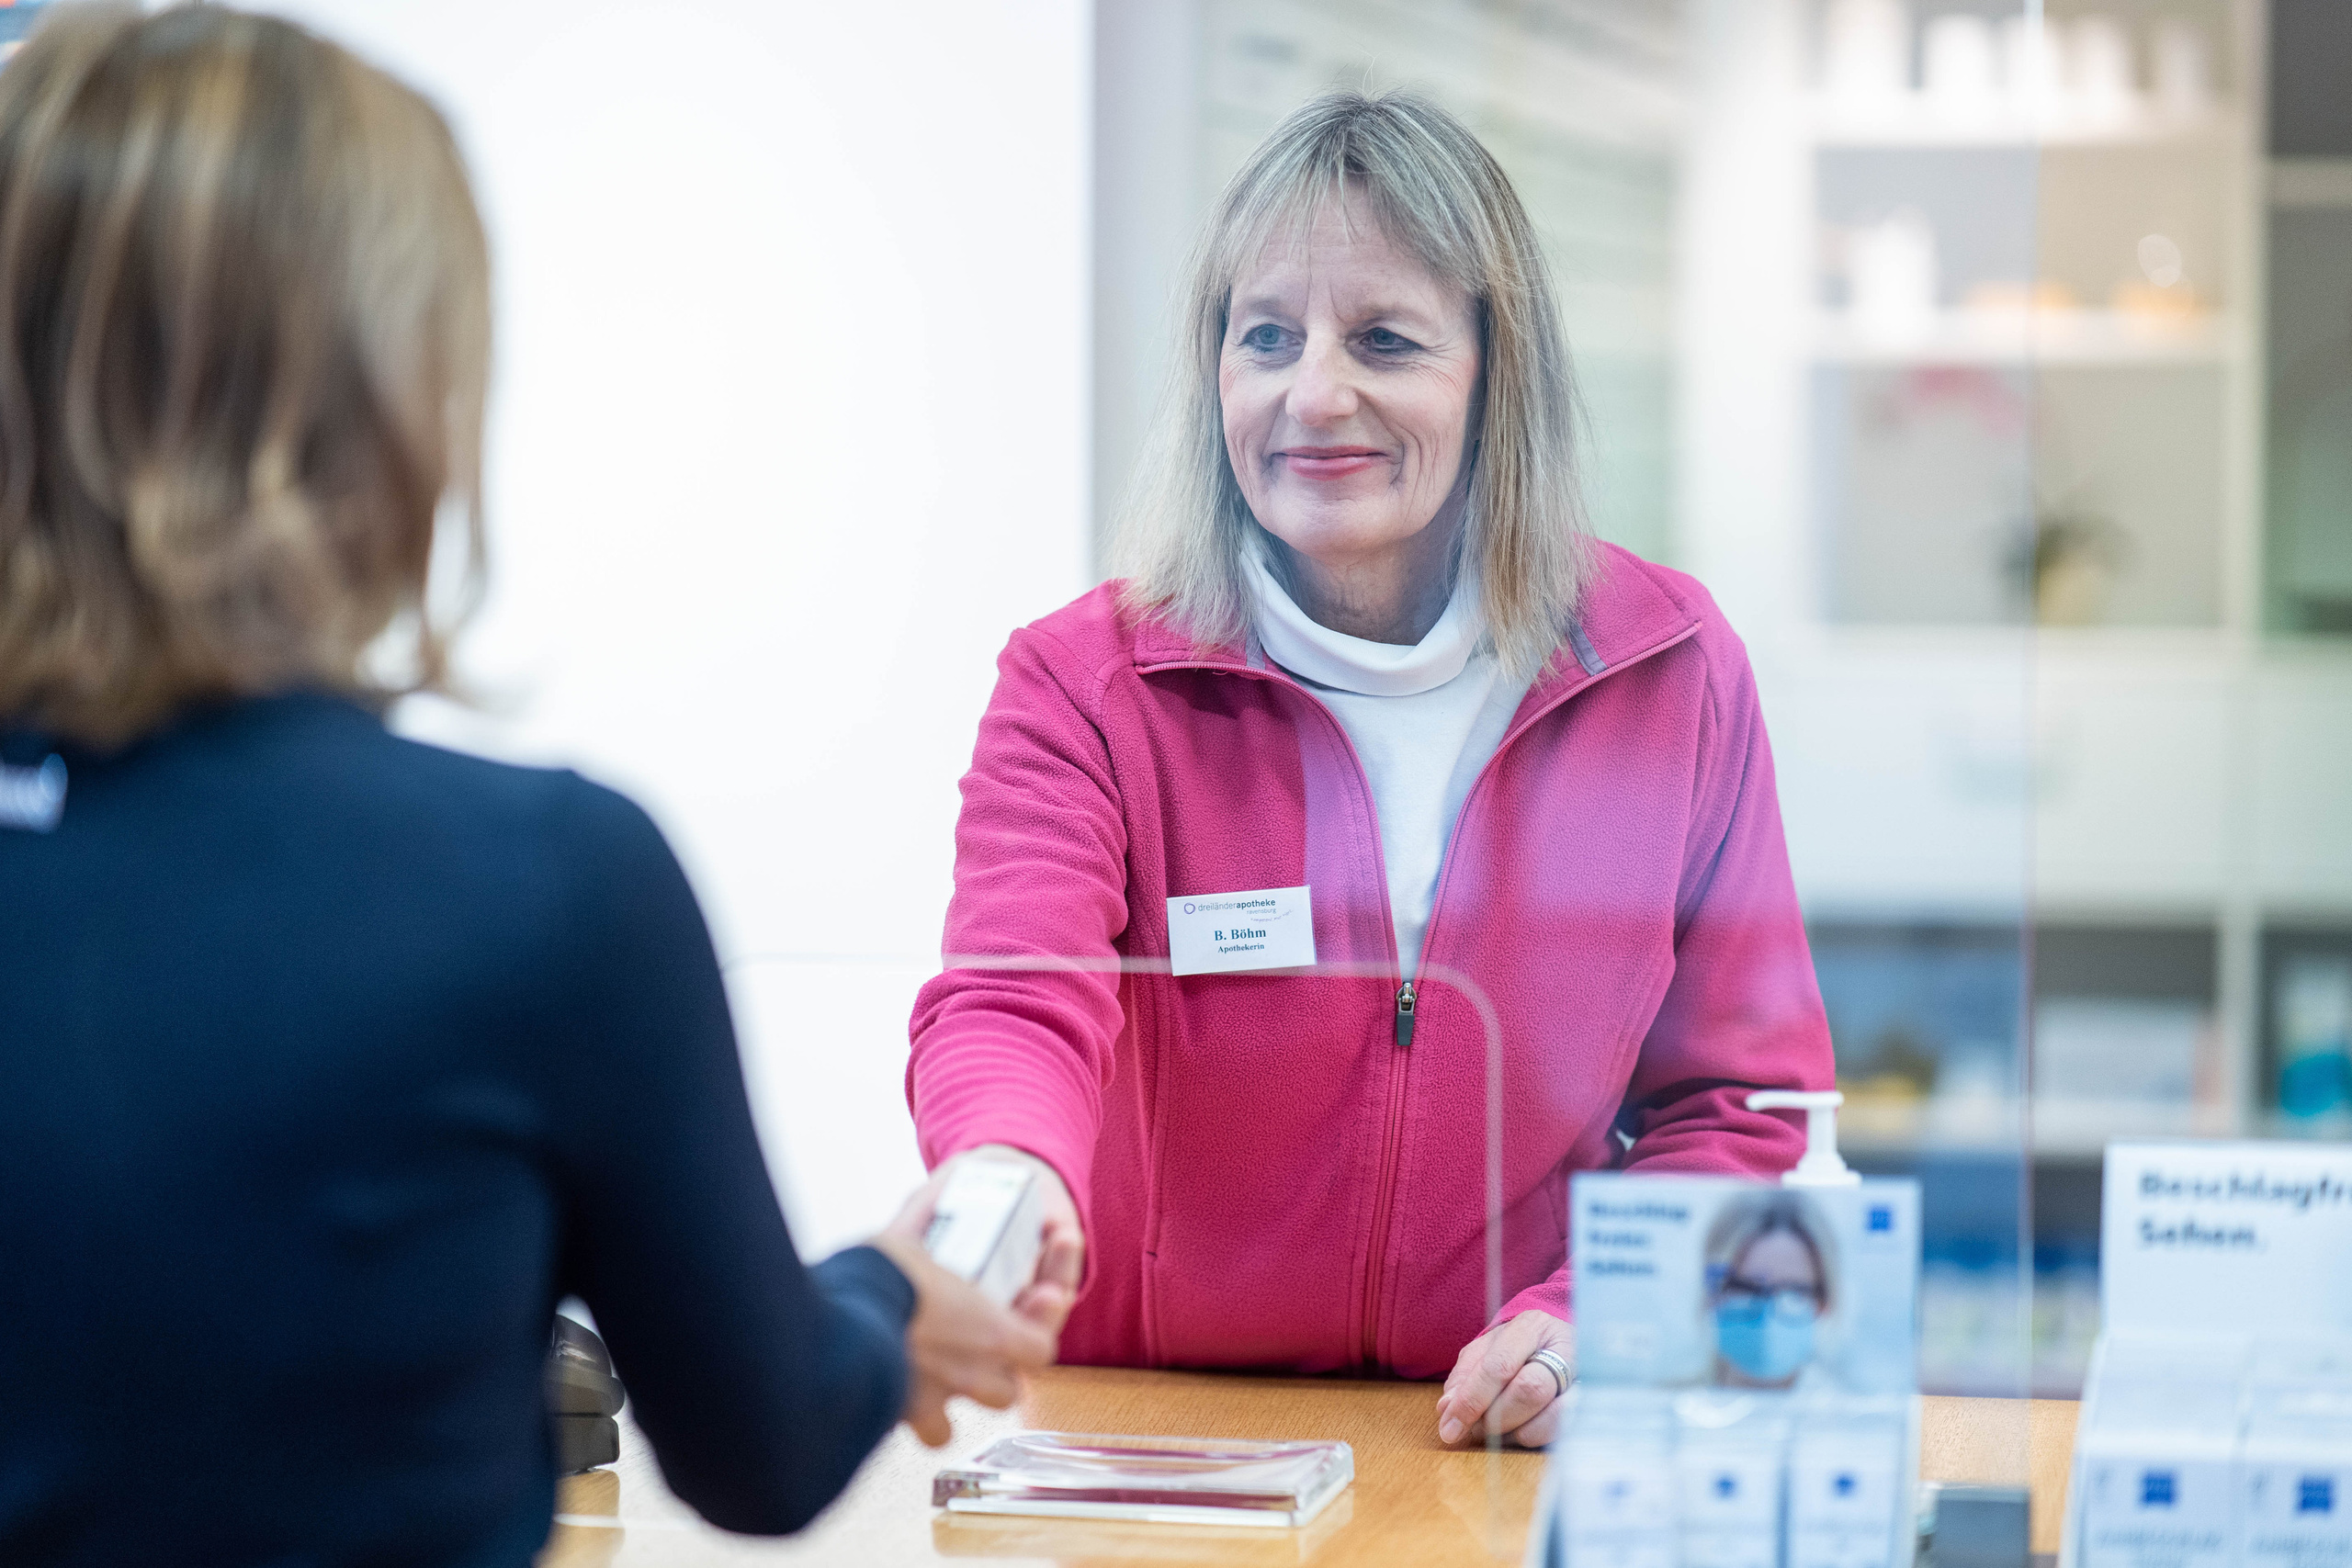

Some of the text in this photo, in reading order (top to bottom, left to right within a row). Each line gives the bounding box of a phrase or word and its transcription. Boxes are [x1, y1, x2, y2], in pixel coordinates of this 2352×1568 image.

[1198, 899, 1276, 911] dreiländerapotheke
[1215, 929, 1266, 941] B. Böhm
[1218, 943, 1265, 953] Apothekerin
[2139, 1171, 2352, 1211] Beschlagfr
